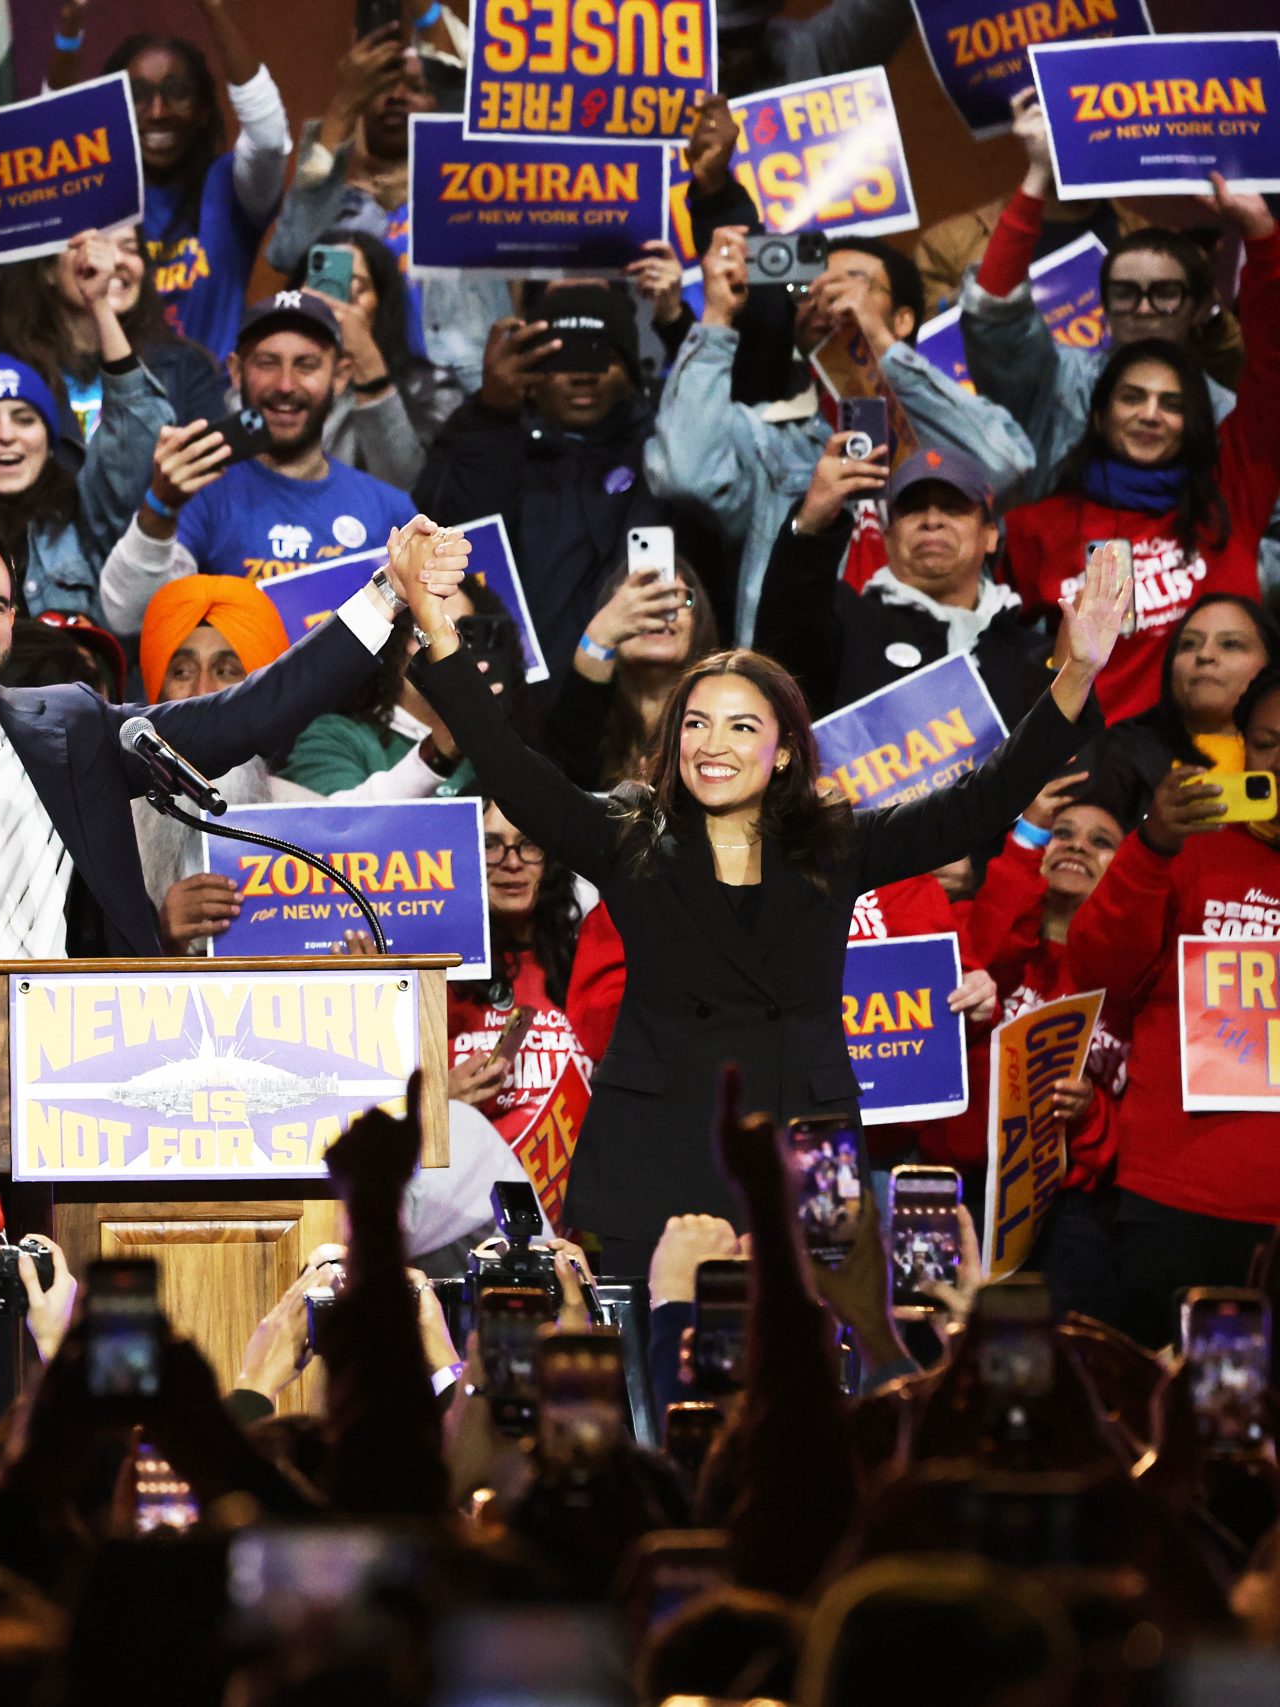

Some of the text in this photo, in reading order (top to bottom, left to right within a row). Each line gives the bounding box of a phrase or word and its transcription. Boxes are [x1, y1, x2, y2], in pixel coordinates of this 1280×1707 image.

[484, 0, 704, 78] BUSES
[947, 0, 1118, 67] ZOHRAN
[478, 80, 573, 132] FREE
[580, 87, 608, 128] &
[780, 80, 877, 142] FREE
[1069, 76, 1267, 122] ZOHRAN
[1116, 122, 1161, 139] NEW
[1166, 121, 1213, 137] YORK
[1219, 120, 1261, 137] CITY
[6, 184, 58, 207] YORK
[62, 172, 105, 197] CITY
[439, 162, 640, 203] ZOHRAN
[477, 209, 524, 225] NEW
[528, 209, 578, 225] YORK
[583, 209, 629, 225] CITY
[932, 755, 975, 789] CITY
[239, 850, 455, 898] ZOHRAN
[249, 907, 278, 924] FOR
[283, 903, 331, 920] NEW
[396, 899, 445, 916] CITY
[25, 983, 407, 1085] NEW YORK
[841, 988, 934, 1037] RAN
[848, 1039, 925, 1060] RK CITY
[1216, 1017, 1259, 1065] THE
[192, 1090, 246, 1122] IS
[25, 1099, 132, 1169] NOT
[148, 1125, 255, 1167] FOR
[995, 1115, 1031, 1262] ALL
